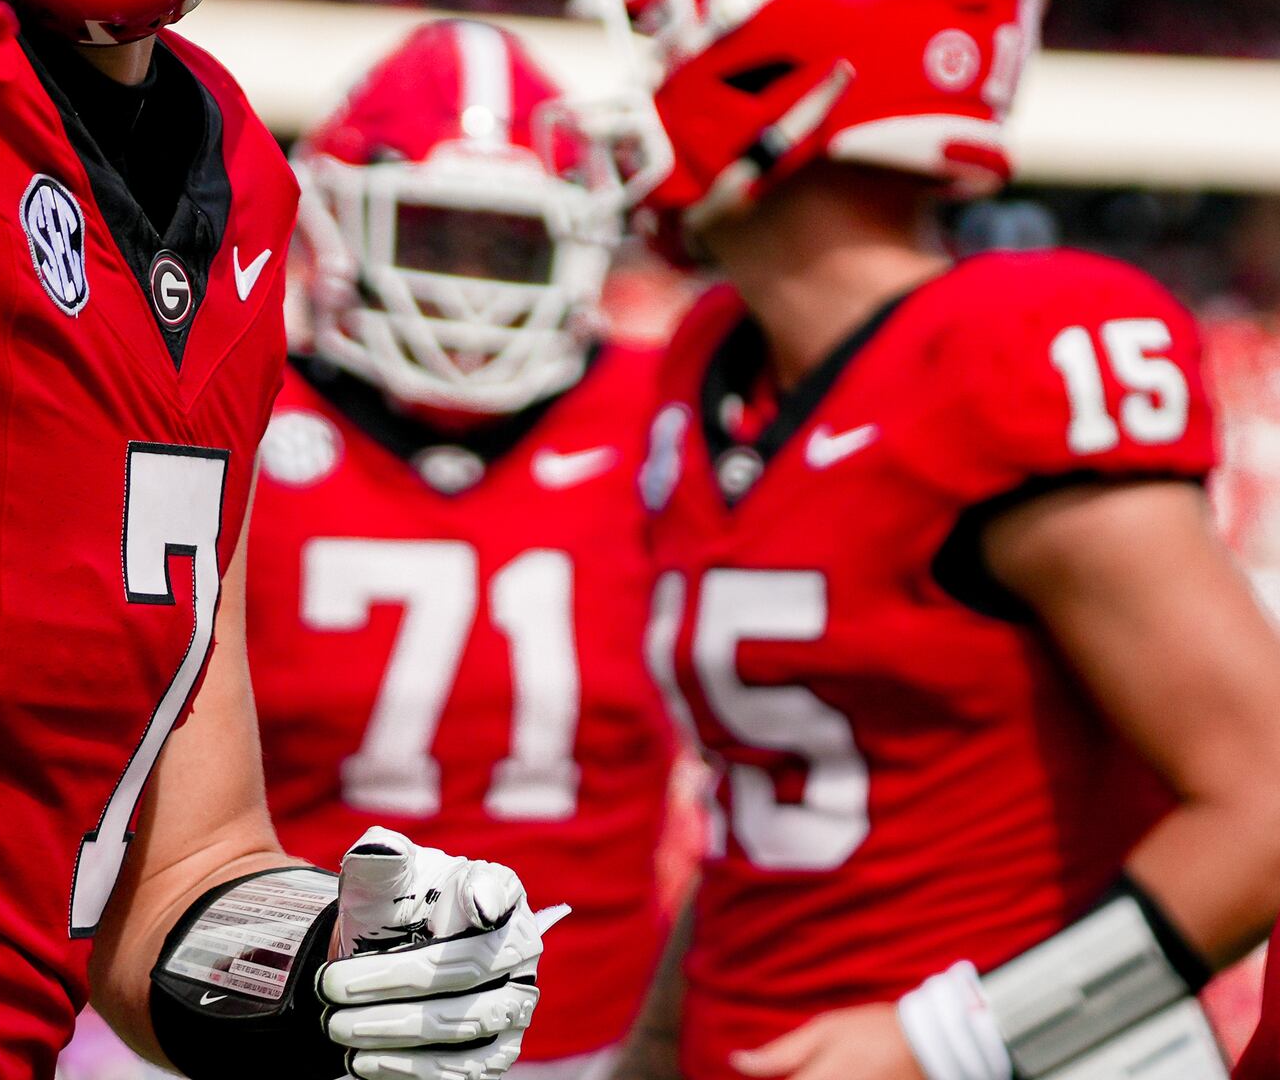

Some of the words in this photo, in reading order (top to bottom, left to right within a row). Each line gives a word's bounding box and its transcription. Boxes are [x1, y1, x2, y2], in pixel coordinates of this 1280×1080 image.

[25, 183, 87, 304] SEC
[152, 257, 194, 325] G
[1048, 317, 1191, 456] 15
[69, 439, 231, 939] 7
[300, 535, 582, 820] 71
